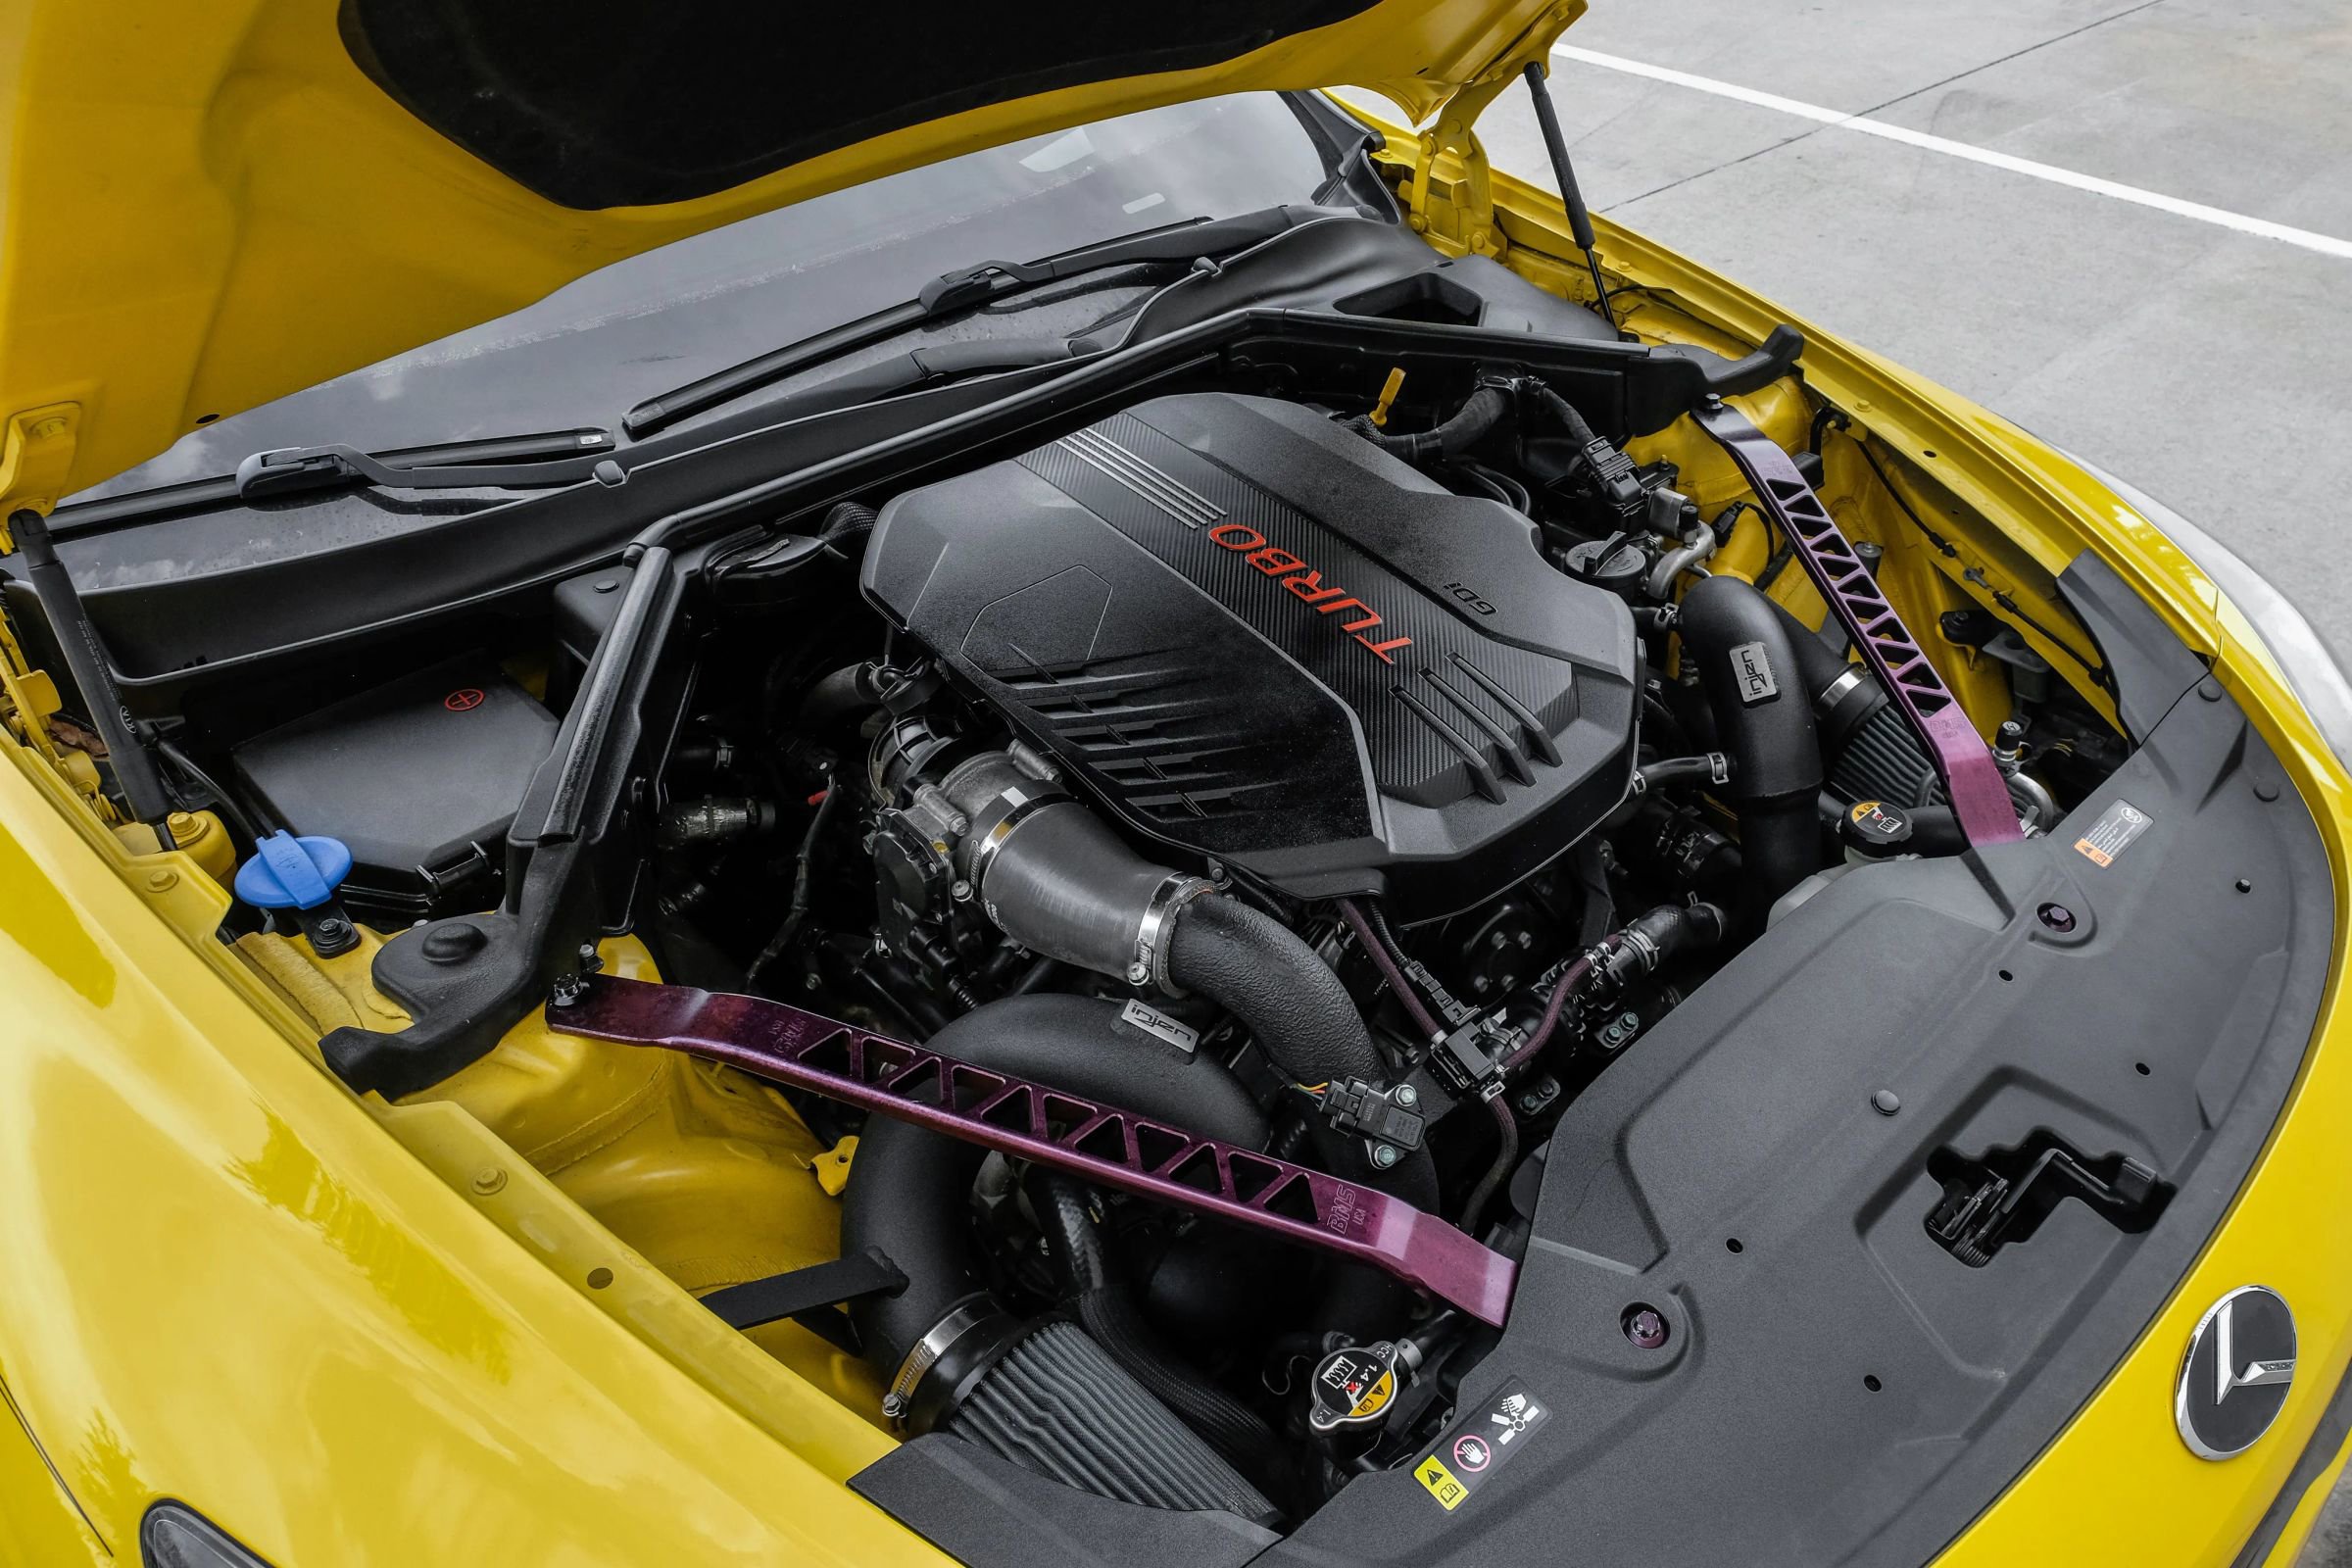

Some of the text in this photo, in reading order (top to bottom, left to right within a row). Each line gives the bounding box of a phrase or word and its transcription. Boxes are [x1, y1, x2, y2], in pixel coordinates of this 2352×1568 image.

[1207, 523, 1414, 665] TURBO
[1740, 649, 1768, 697] injen
[1130, 1004, 1193, 1042] injen
[1326, 1183, 1356, 1235] BMS
[1376, 1343, 1393, 1359] HCC
[1359, 1363, 1378, 1383] 1.4
[1316, 1408, 1332, 1423] 1.4
